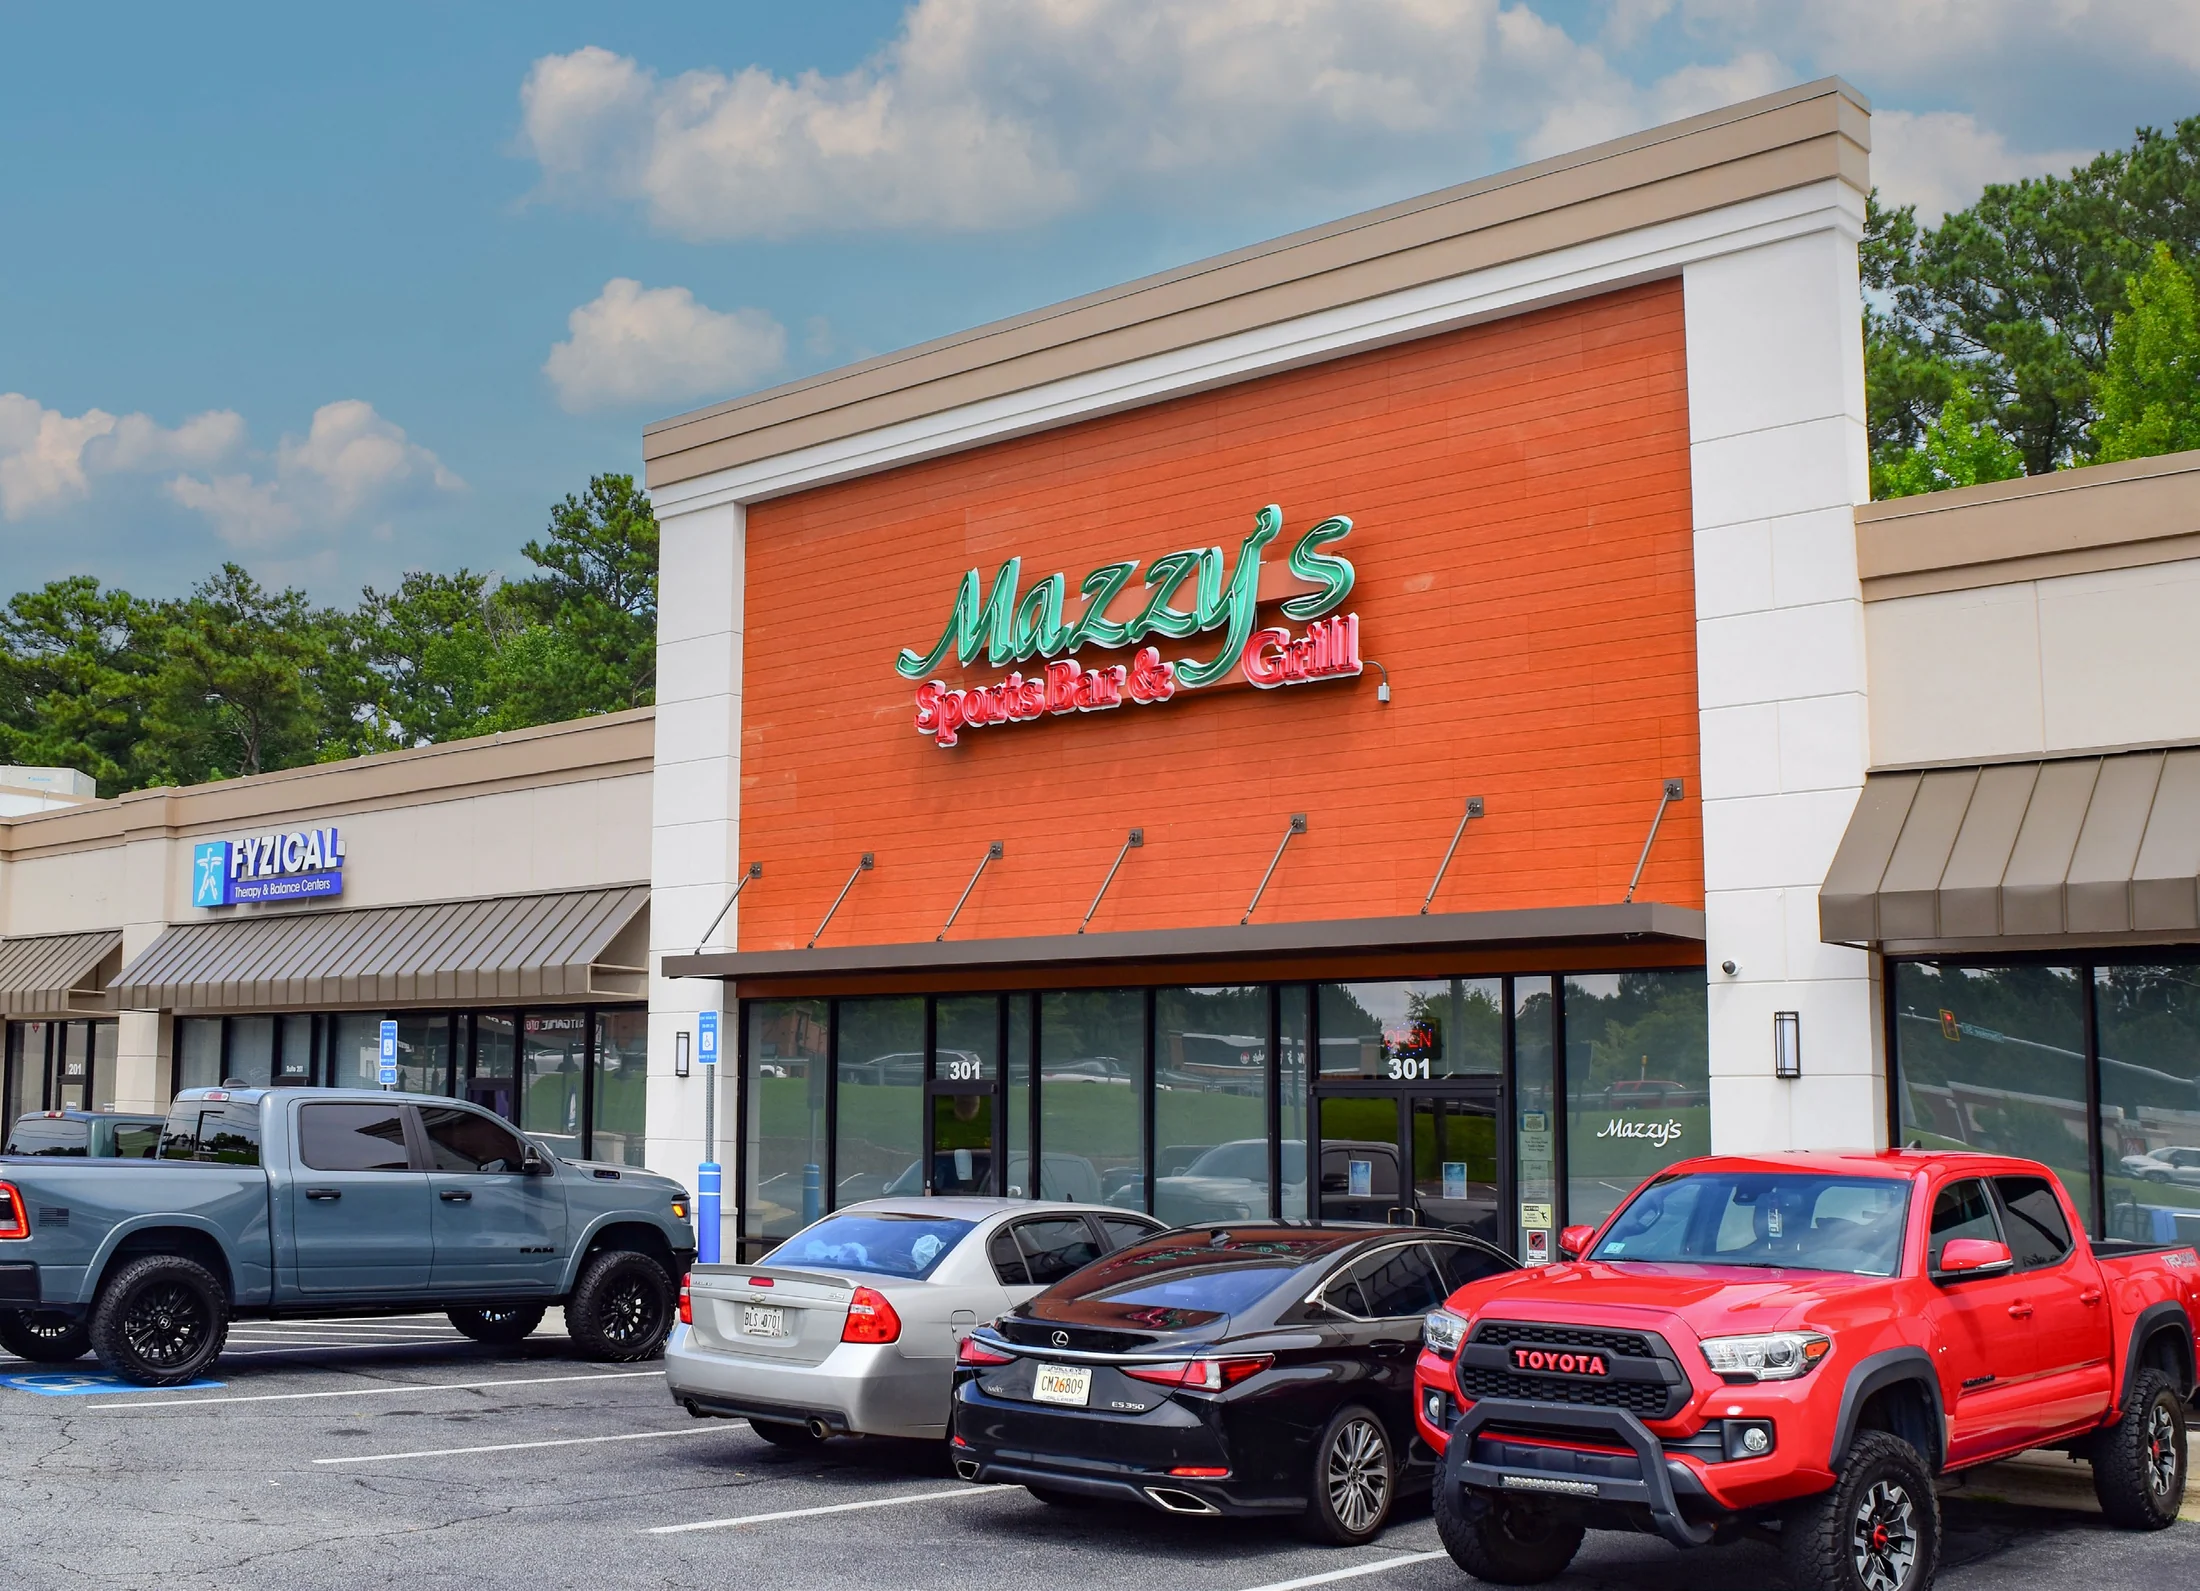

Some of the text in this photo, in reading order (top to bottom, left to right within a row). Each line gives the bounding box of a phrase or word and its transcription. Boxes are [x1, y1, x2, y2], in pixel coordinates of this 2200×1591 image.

[895, 503, 1355, 688] Mazzy's
[914, 612, 1363, 748] Sports Bar & Grill
[230, 828, 338, 878] FYZICAL
[235, 879, 331, 899] Therapy & Balance Centers
[1384, 1030, 1432, 1048] OPEN
[68, 1063, 82, 1075] 201
[950, 1061, 980, 1080] 301
[1388, 1058, 1429, 1080] 301
[1596, 1118, 1682, 1148] Mazzy's
[744, 1312, 781, 1329] BLS 0701
[1515, 1350, 1605, 1375] TOYOTA
[1041, 1375, 1084, 1395] CMZ6809
[1125, 1402, 1145, 1410] 350
